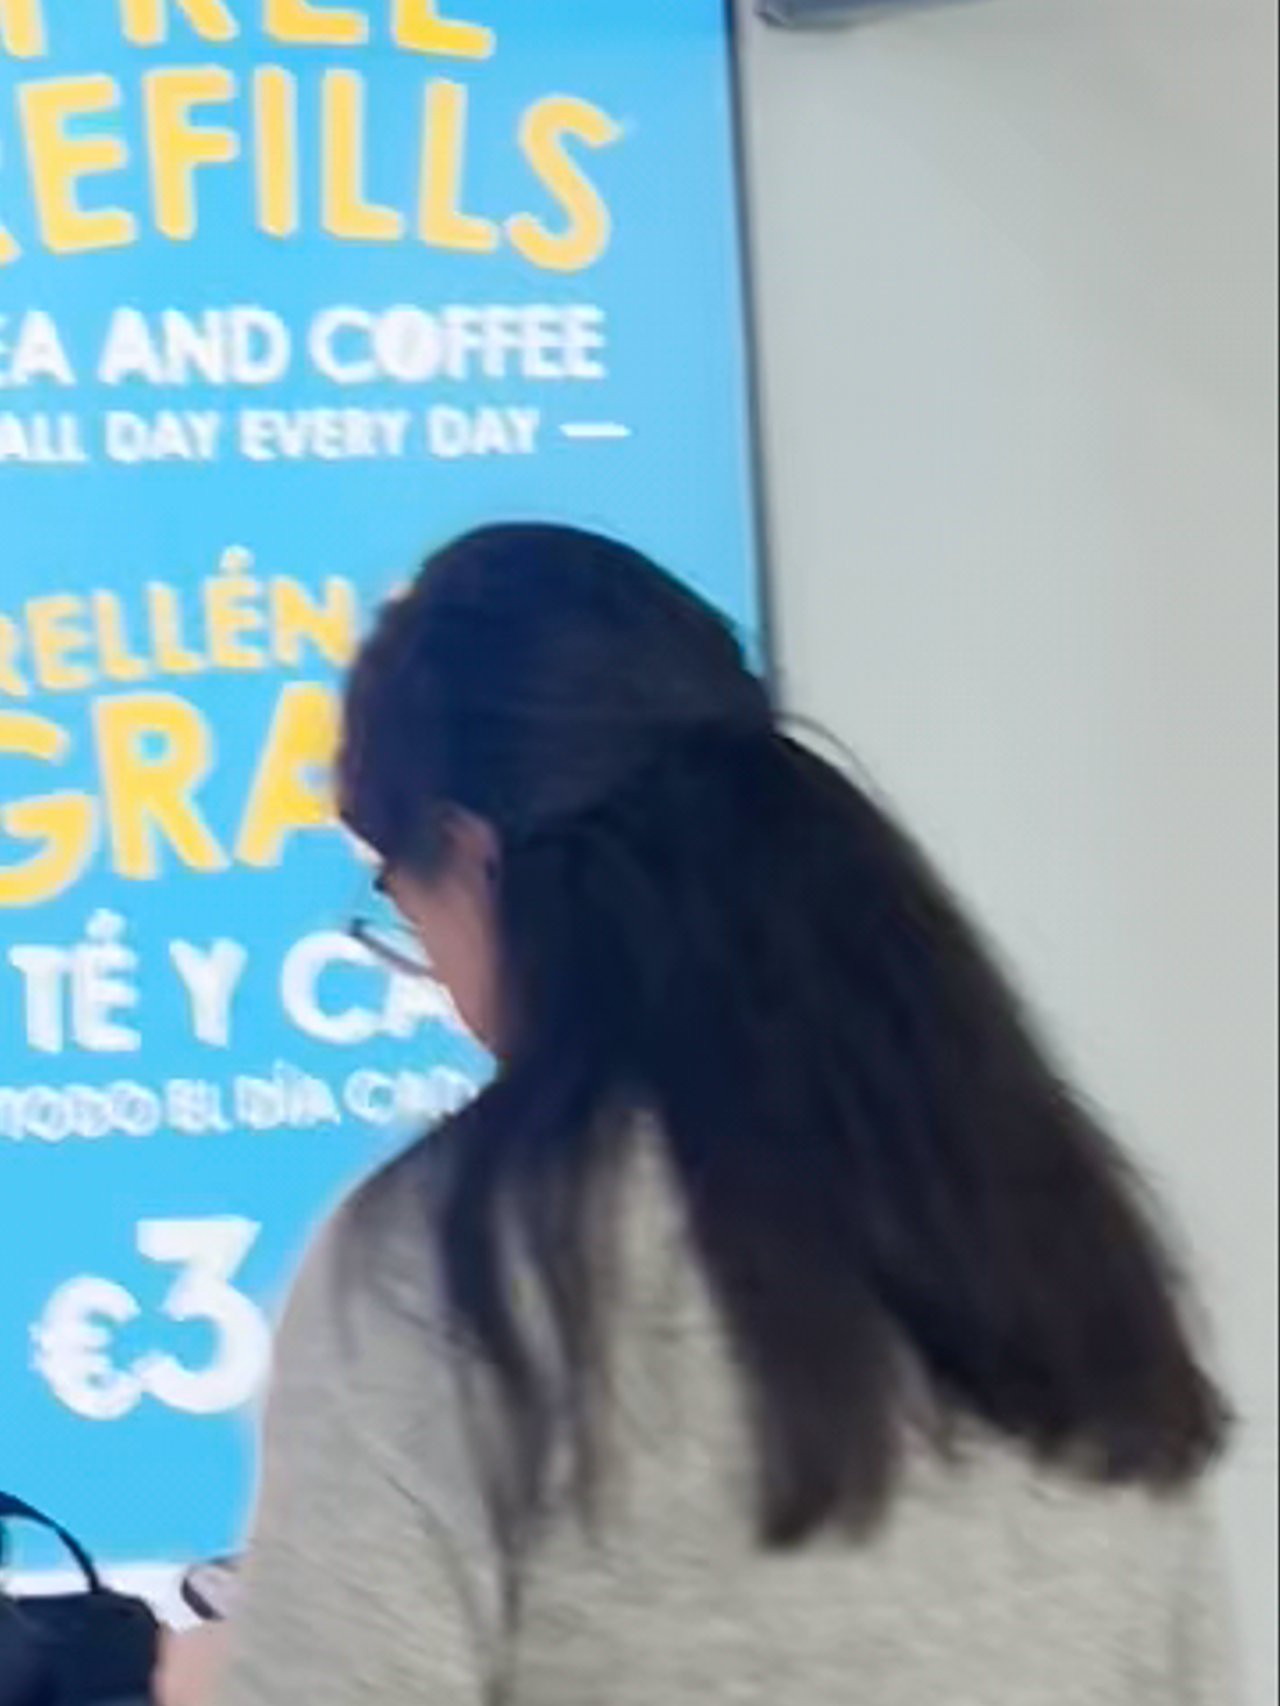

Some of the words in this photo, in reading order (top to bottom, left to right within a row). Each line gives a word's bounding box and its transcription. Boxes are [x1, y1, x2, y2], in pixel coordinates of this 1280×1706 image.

[97, 305, 293, 386] AND
[308, 304, 608, 383] COFFEE
[103, 409, 222, 462] DAY
[238, 409, 414, 461] EVERY
[426, 404, 541, 456] DAY
[7, 907, 142, 1053] TÉ
[167, 936, 248, 1049] Y
[279, 928, 478, 1046] CA
[162, 1079, 232, 1135] EL
[344, 1066, 480, 1127] CAD
[27, 1214, 272, 1421] €3
